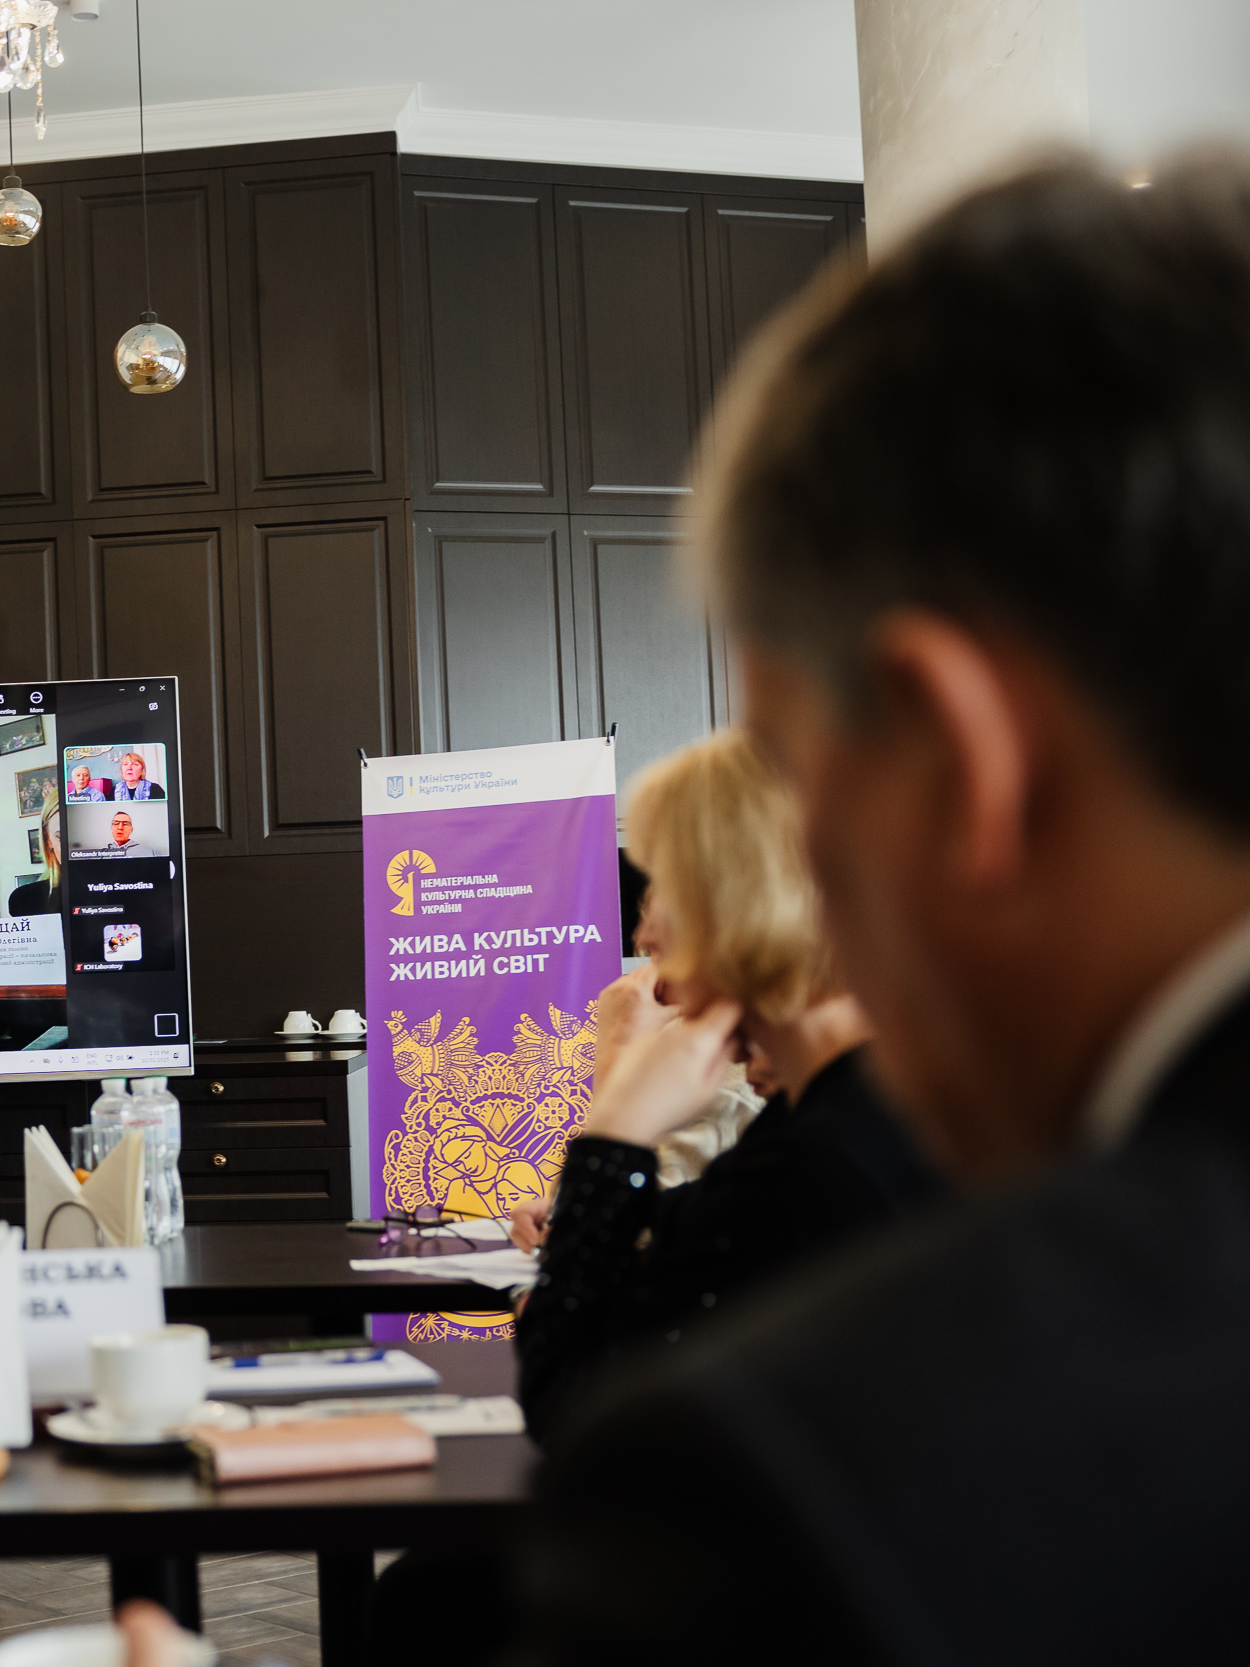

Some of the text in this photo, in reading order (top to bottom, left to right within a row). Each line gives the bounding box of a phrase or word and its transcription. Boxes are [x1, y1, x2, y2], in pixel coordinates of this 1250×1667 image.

[419, 770, 492, 784] Міністерство
[419, 778, 518, 795] культури України
[87, 881, 154, 893] Yuliya Savostina
[421, 874, 498, 888] НЕМАТЕРІАЛЬНА
[421, 885, 533, 902] КУЛЬТУРНА СПАДЩИНА
[421, 902, 462, 915] УКРАЇНИ
[388, 924, 602, 956] ЖИВА КУЛЬТУРА
[388, 953, 550, 982] ЖИВИЙ СВІТ
